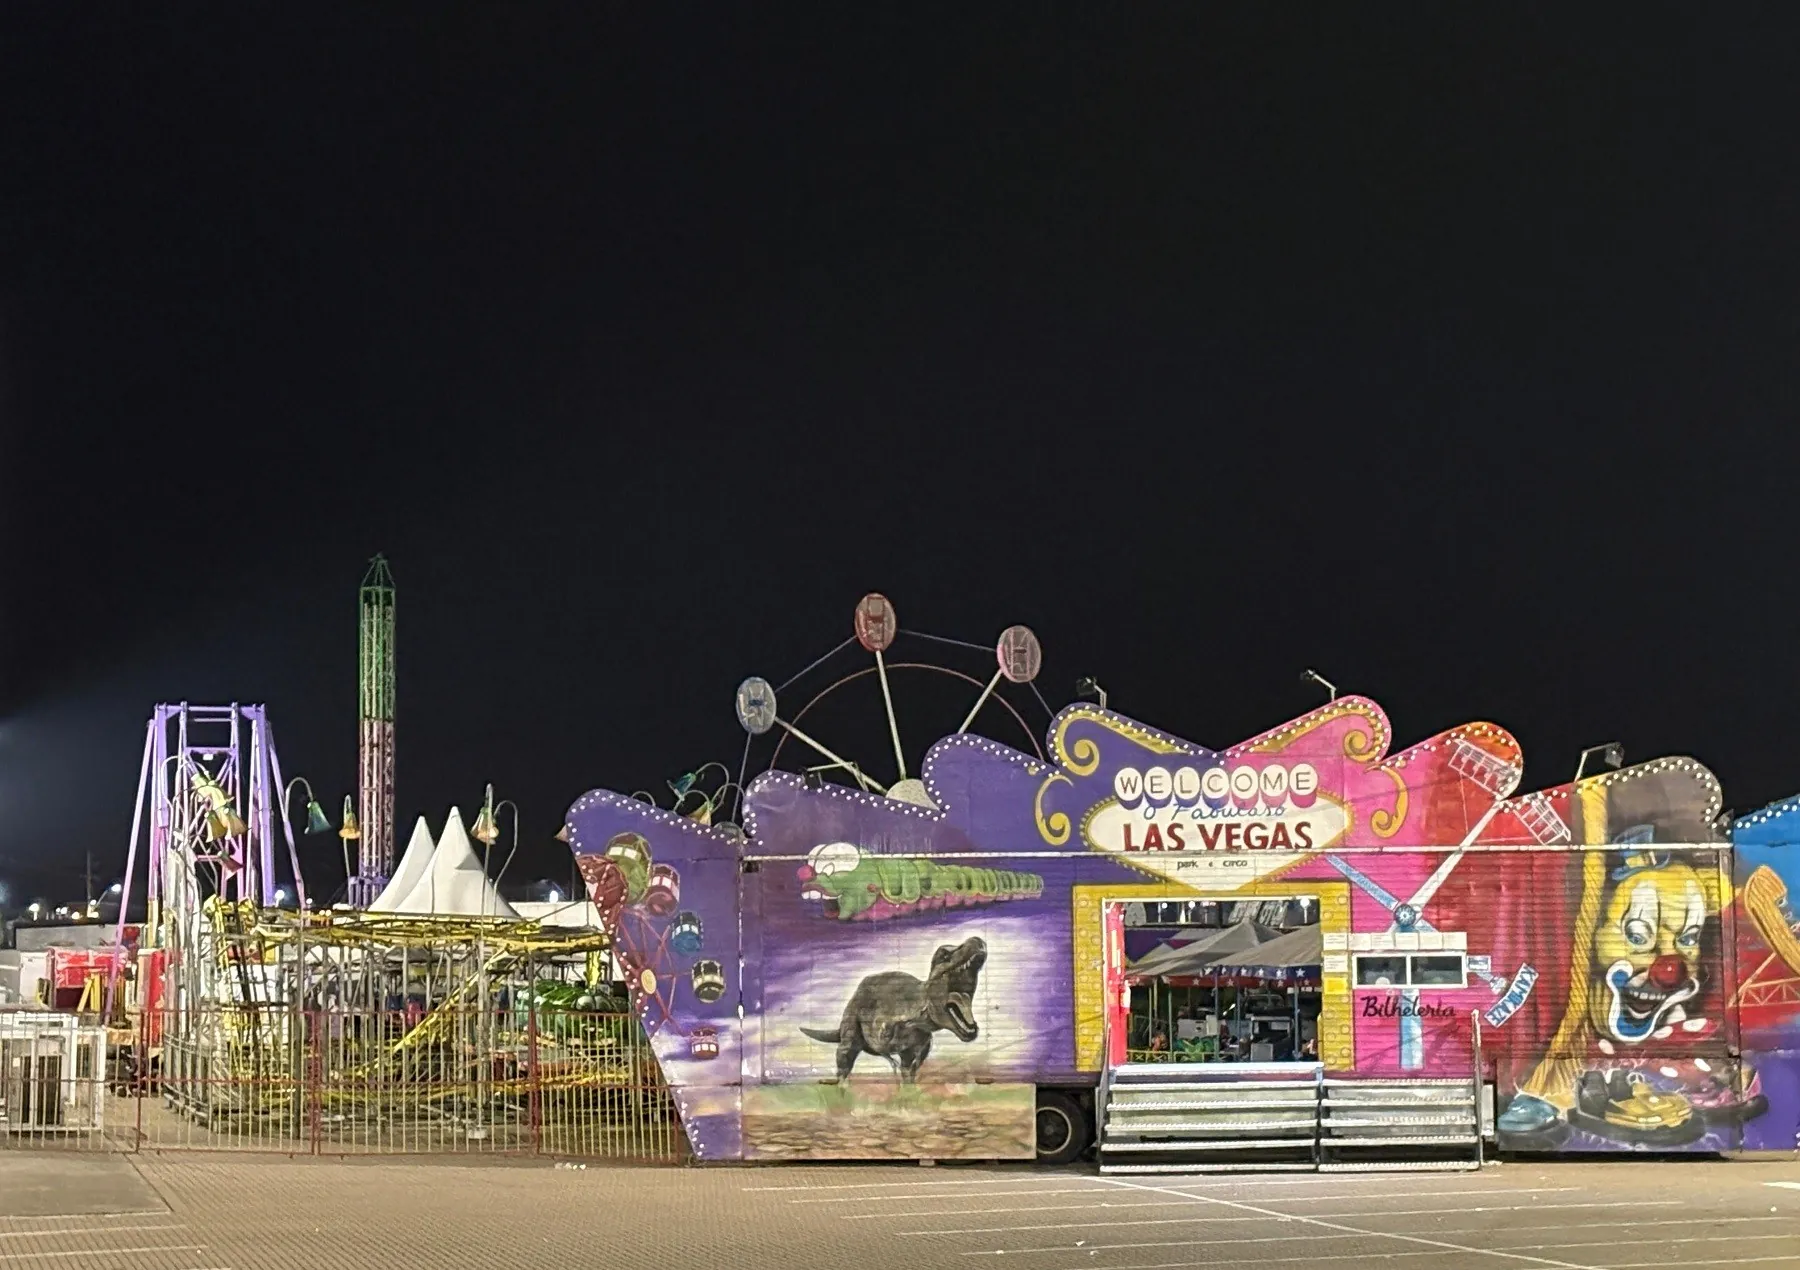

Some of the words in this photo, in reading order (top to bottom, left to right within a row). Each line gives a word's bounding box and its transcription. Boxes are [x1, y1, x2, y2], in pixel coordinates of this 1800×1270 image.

[1118, 770, 1312, 795] WELCOME
[1123, 822, 1187, 851] LAS
[1196, 821, 1314, 851] VEGAS
[1177, 859, 1199, 871] park
[1360, 995, 1456, 1018] Bilheteria
